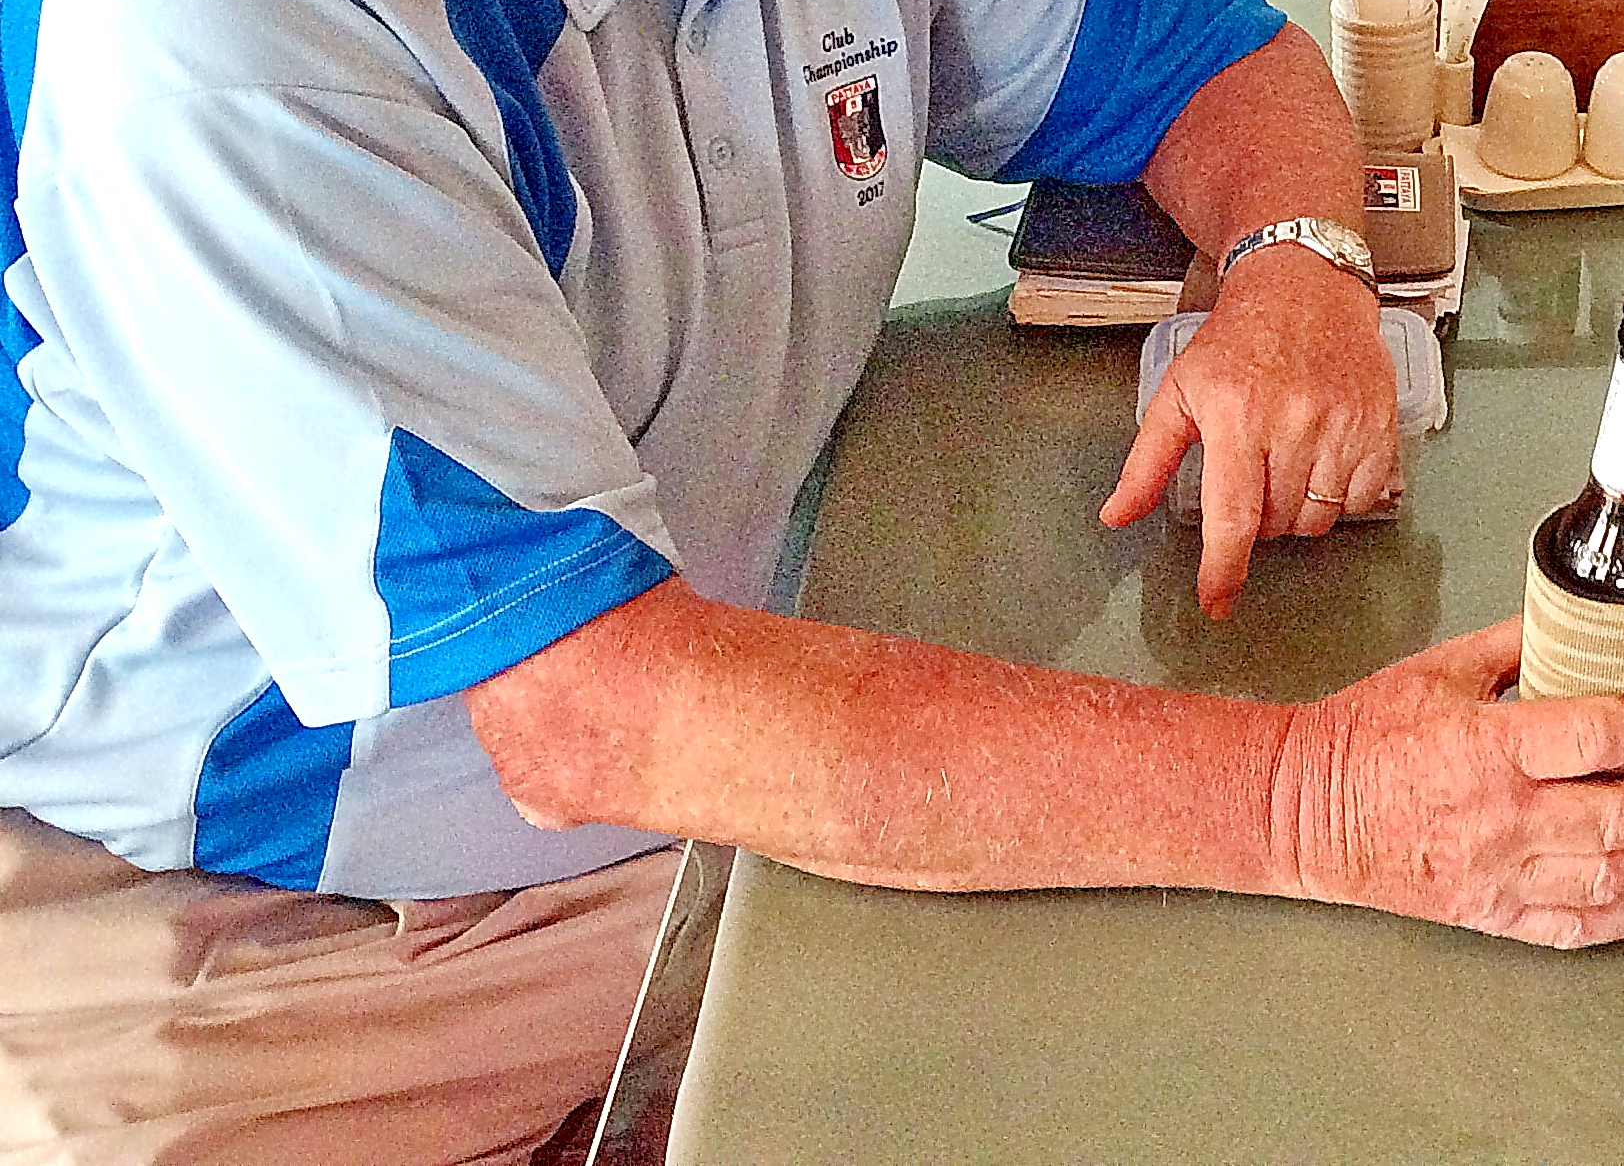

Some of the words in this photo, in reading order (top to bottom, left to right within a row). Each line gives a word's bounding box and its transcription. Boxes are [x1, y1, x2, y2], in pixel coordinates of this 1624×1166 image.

[822, 26, 855, 53] Club
[802, 37, 898, 86] Championship
[857, 181, 885, 207] 2017
